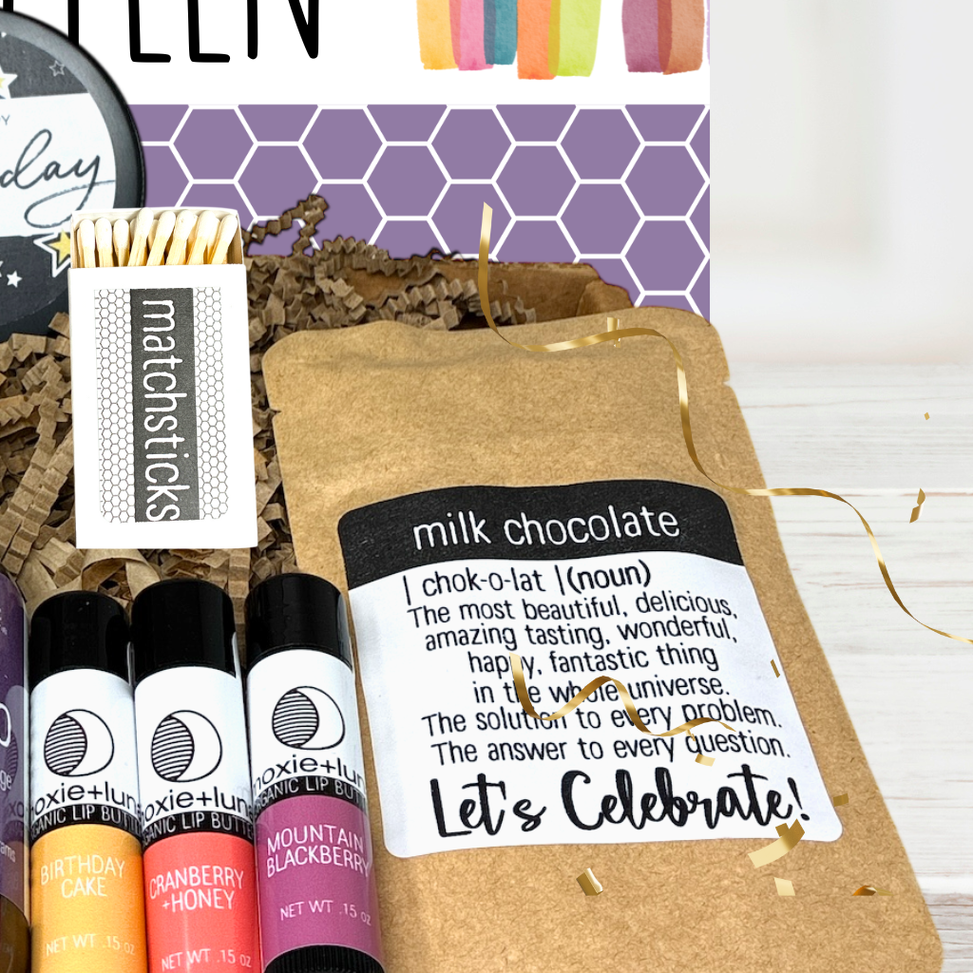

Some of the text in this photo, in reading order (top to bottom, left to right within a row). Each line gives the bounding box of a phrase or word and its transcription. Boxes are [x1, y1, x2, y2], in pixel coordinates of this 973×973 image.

[141, 299, 191, 522] matchsticks
[412, 504, 681, 551] milk chocolate
[407, 589, 738, 628] The most beautiful, delicious,
[425, 614, 738, 651] amazing tasting, wonderful,
[467, 642, 720, 680] hapy, fantastic thing
[472, 680, 495, 704] in
[627, 674, 730, 699] universe.
[421, 711, 467, 737] The
[575, 707, 602, 729] to
[430, 728, 791, 766] The answer to every question.
[305, 775, 330, 792] LIP
[72, 804, 97, 822] LIP
[429, 763, 811, 838] Let's Celebrate!
[181, 811, 206, 830] LIP
[210, 811, 254, 841] BUTTE
[267, 824, 365, 856] MOUNTAIN
[40, 854, 127, 886] BIRTHDAY
[266, 844, 370, 878] BLACKBERRY
[60, 876, 108, 899] CAKE
[149, 864, 245, 900] CRANBERRY
[279, 900, 305, 921] NET
[308, 899, 334, 913] WT
[45, 935, 67, 957] NET
[72, 932, 97, 949] WT
[161, 951, 184, 973] NET
[186, 947, 212, 965] WT
